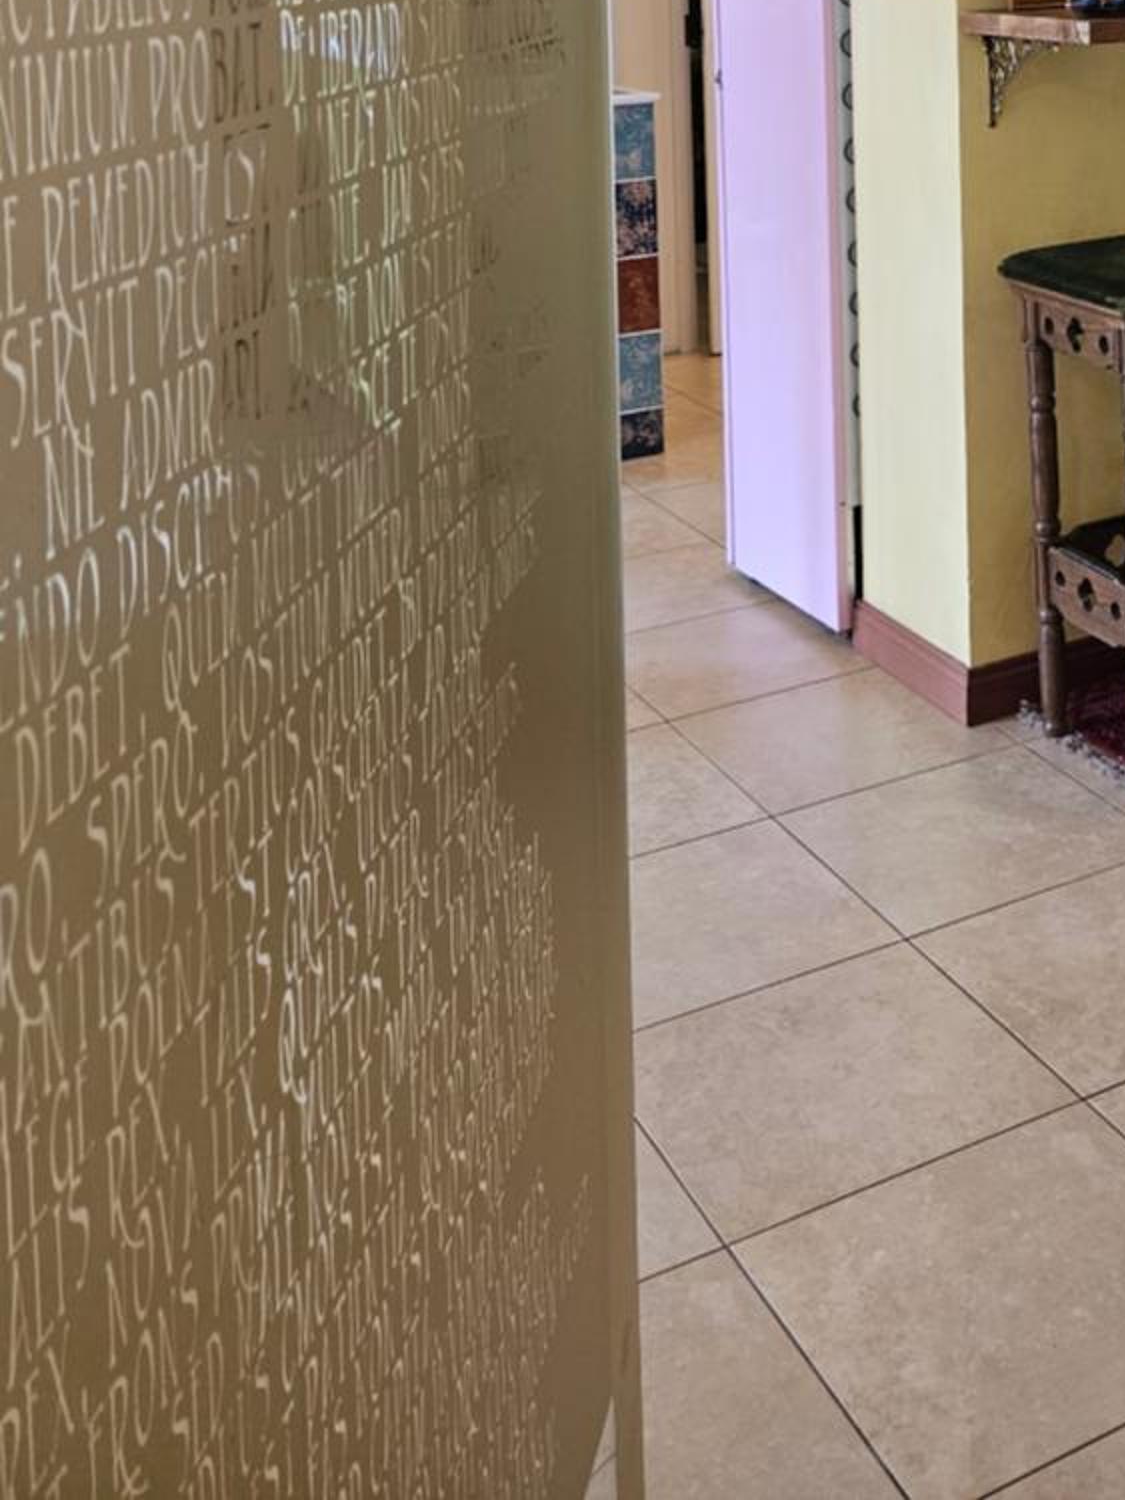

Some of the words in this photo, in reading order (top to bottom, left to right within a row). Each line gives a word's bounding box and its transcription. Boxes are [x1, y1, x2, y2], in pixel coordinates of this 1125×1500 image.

[42, 134, 212, 309] REMEDIUM
[0, 274, 139, 459] SERVIT
[14, 620, 147, 876] DEBET,
[160, 541, 241, 722] QUEM
[188, 695, 300, 931] TERTIUS
[103, 1121, 199, 1391] NOVA
[277, 881, 358, 1110] QUALIS
[190, 911, 272, 1135] TALIS
